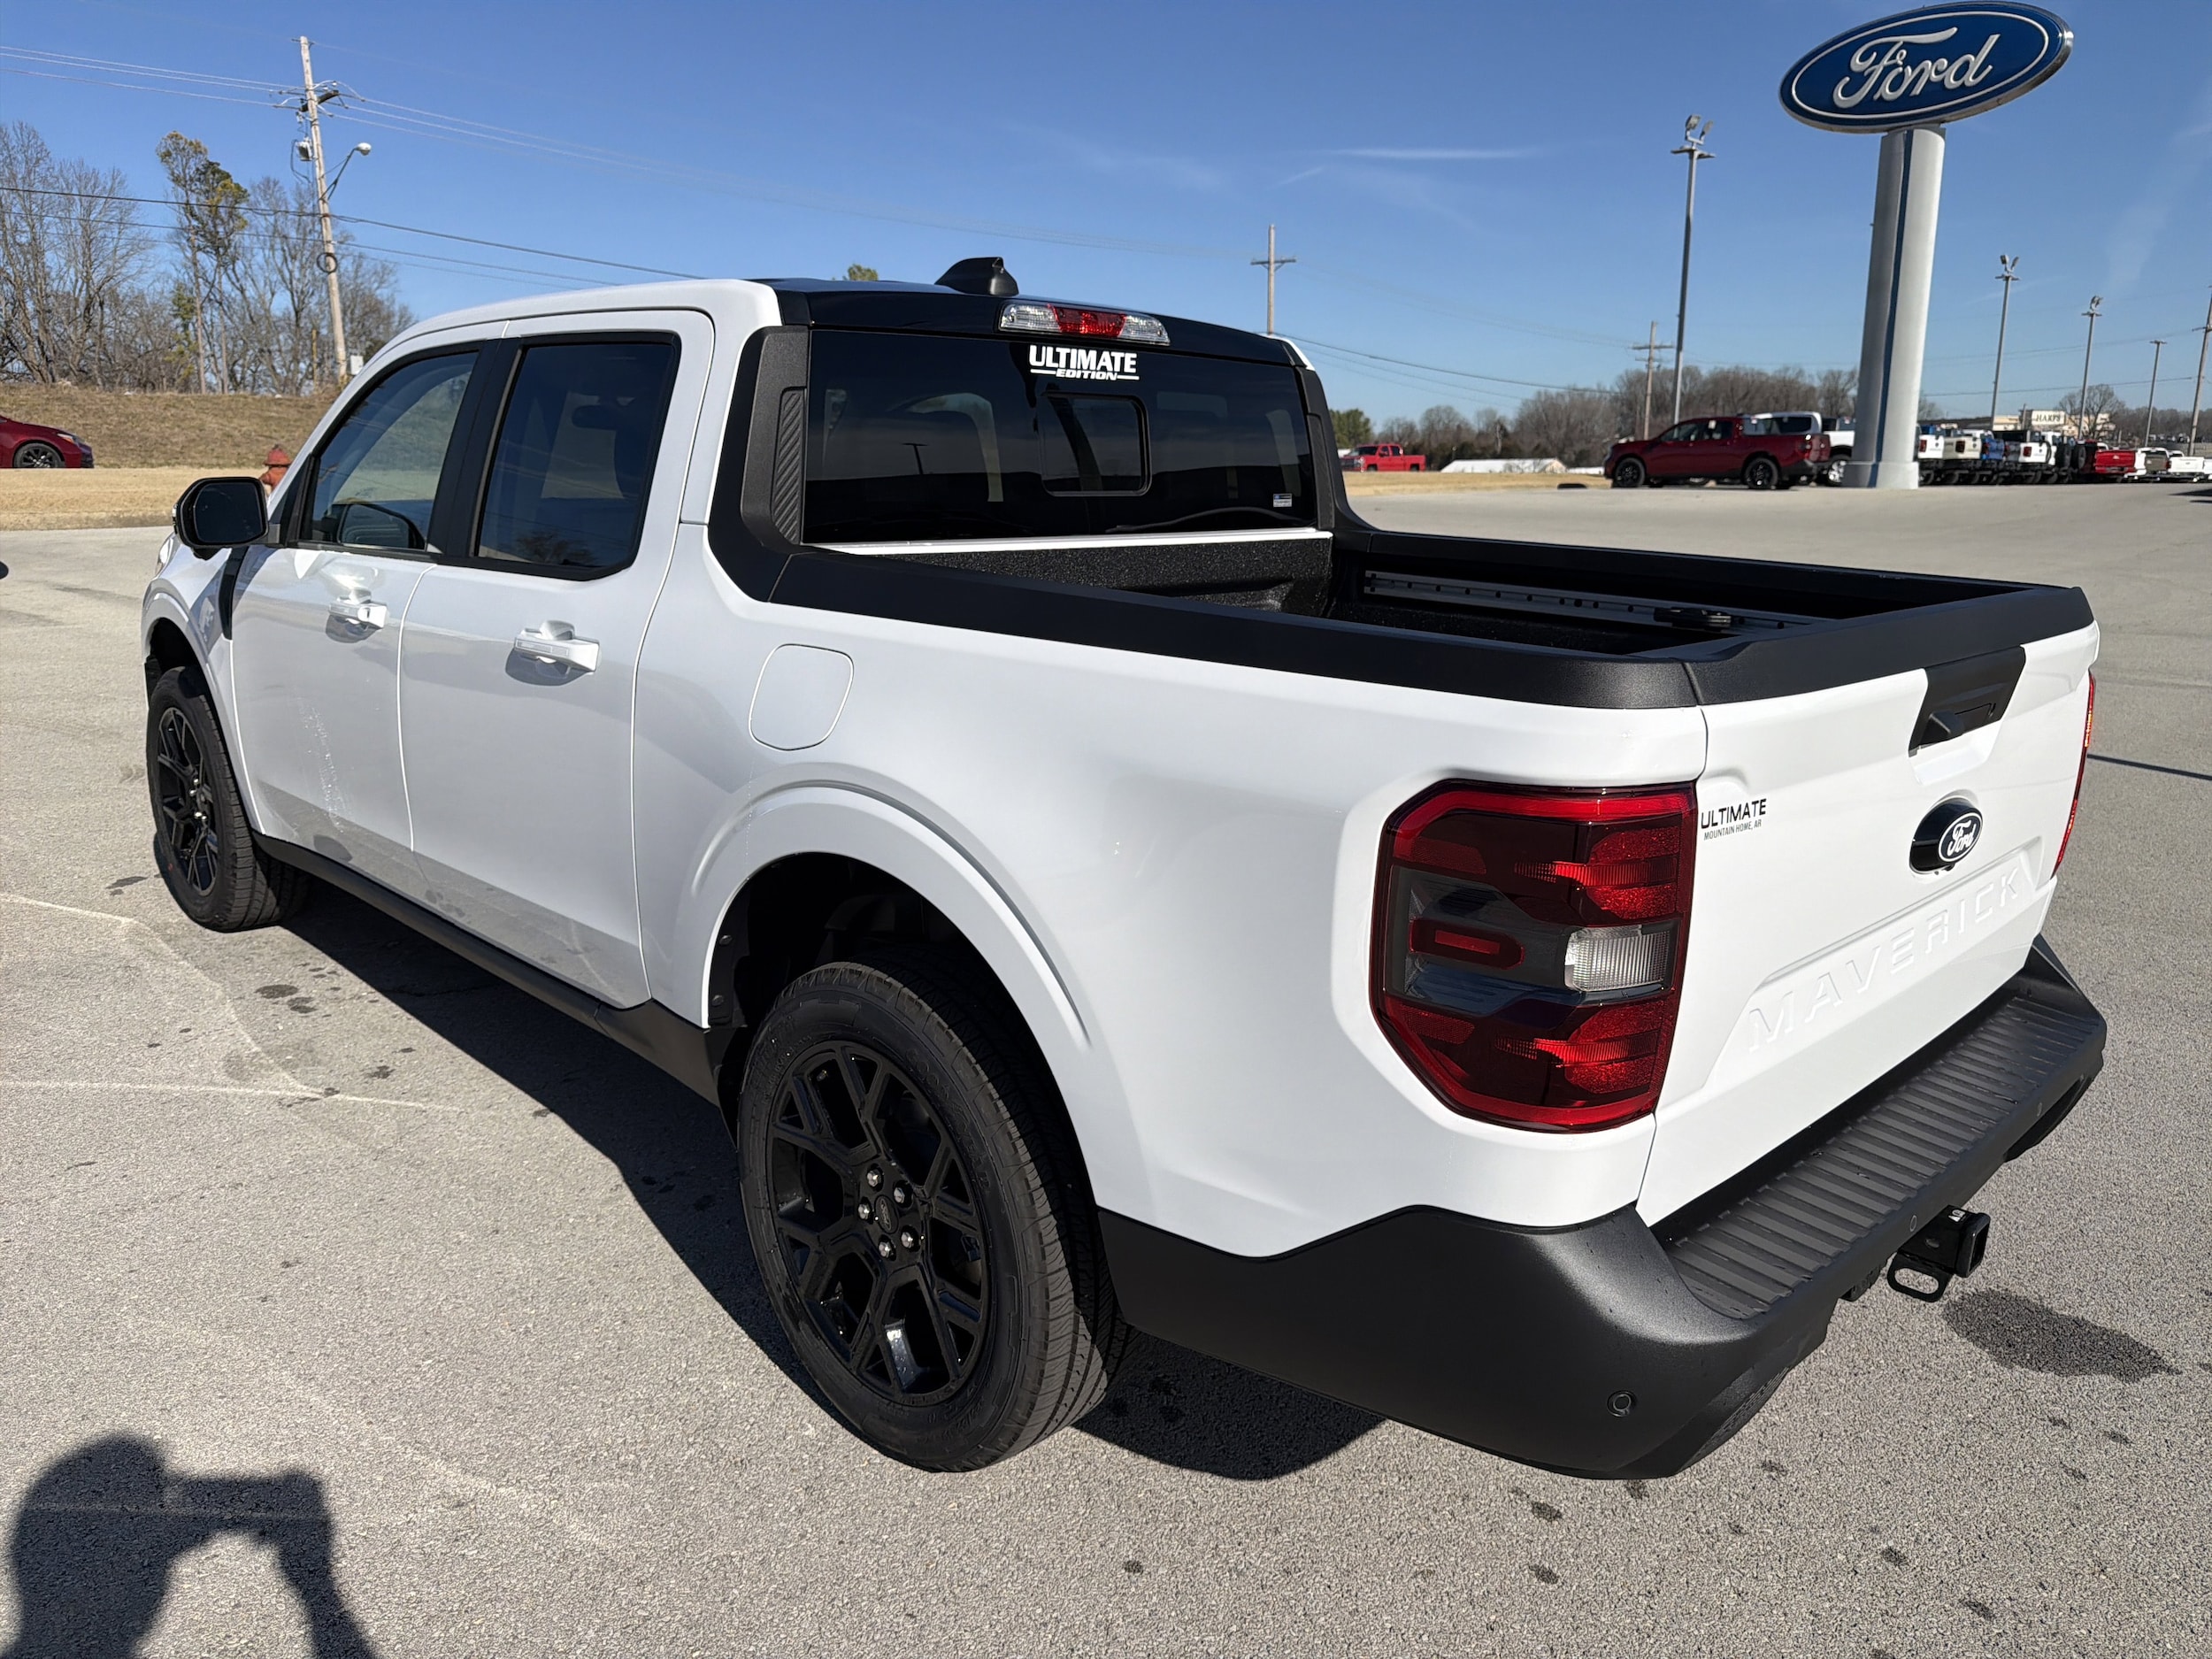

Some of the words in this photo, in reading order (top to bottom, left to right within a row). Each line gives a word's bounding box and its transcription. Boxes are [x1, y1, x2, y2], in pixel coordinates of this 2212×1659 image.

[1833, 27, 2001, 108] Ford
[1028, 344, 1138, 373] ULTIMATE
[1056, 368, 1118, 380] EDITION
[1701, 798, 1767, 829] ULTIMATE
[1704, 826, 1735, 841] MOUNTAIN
[1754, 819, 1762, 828] AR
[1947, 819, 1977, 856] Ford
[1747, 864, 2020, 1053] MAVERICK
